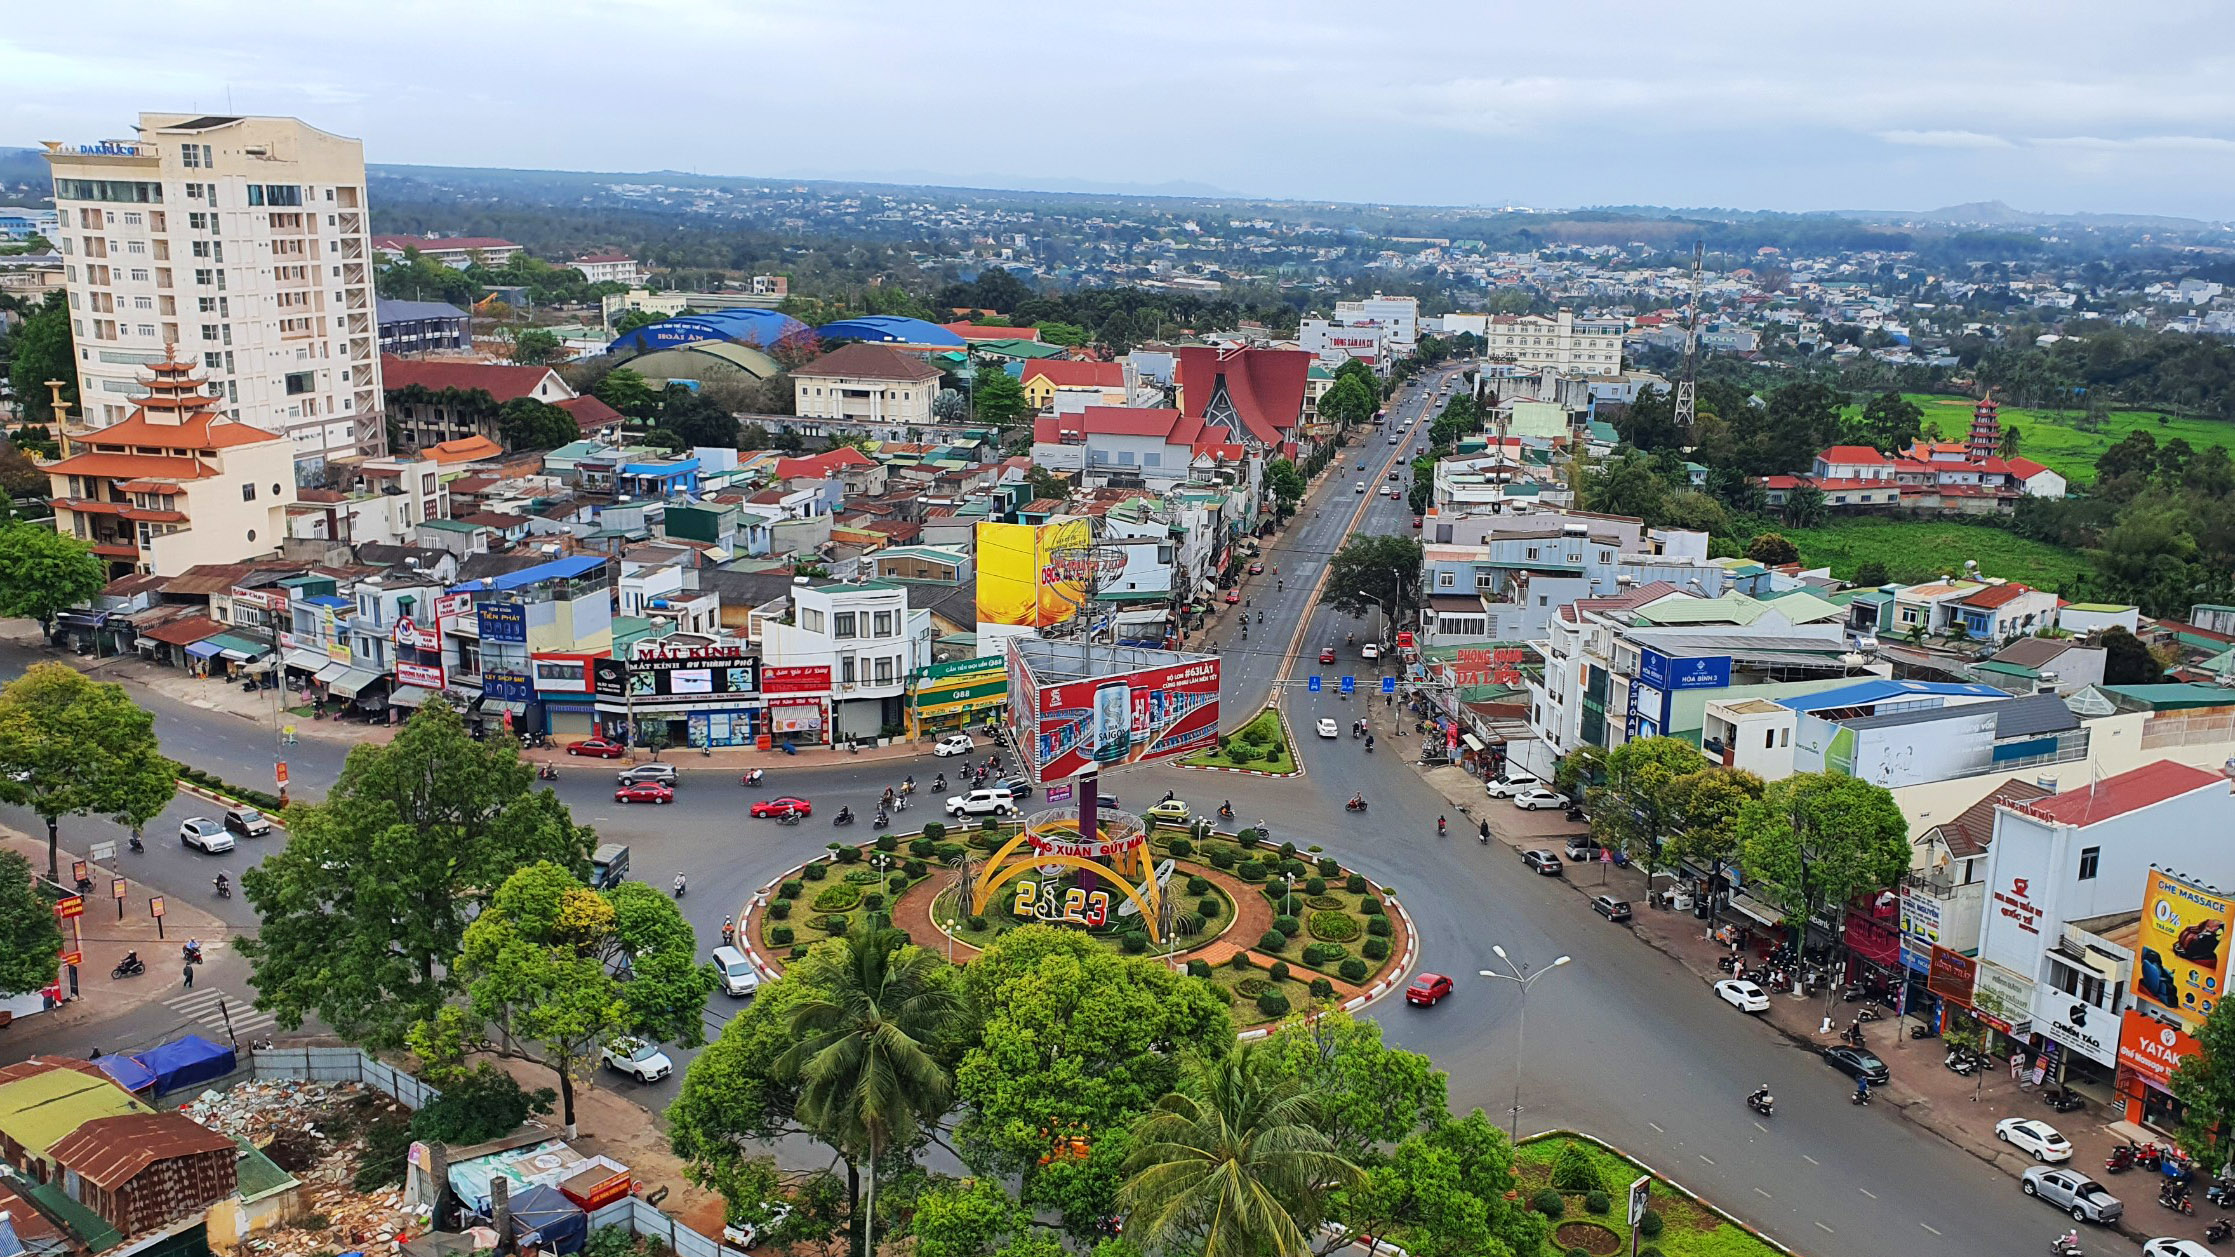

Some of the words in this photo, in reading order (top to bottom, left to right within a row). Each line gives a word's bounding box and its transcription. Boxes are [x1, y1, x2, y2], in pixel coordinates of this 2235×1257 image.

[690, 645, 741, 660] KÍNH
[1681, 675, 1696, 683] HÒA
[1697, 674, 1713, 682] BÌNH
[1098, 728, 1127, 742] SAIGON
[1056, 844, 1092, 857] XUÂN
[2179, 889, 2226, 913] MASSAGE
[2000, 907, 2021, 921] QUỐC
[2081, 1033, 2100, 1048] TÁO
[2135, 1052, 2164, 1073] Massage
